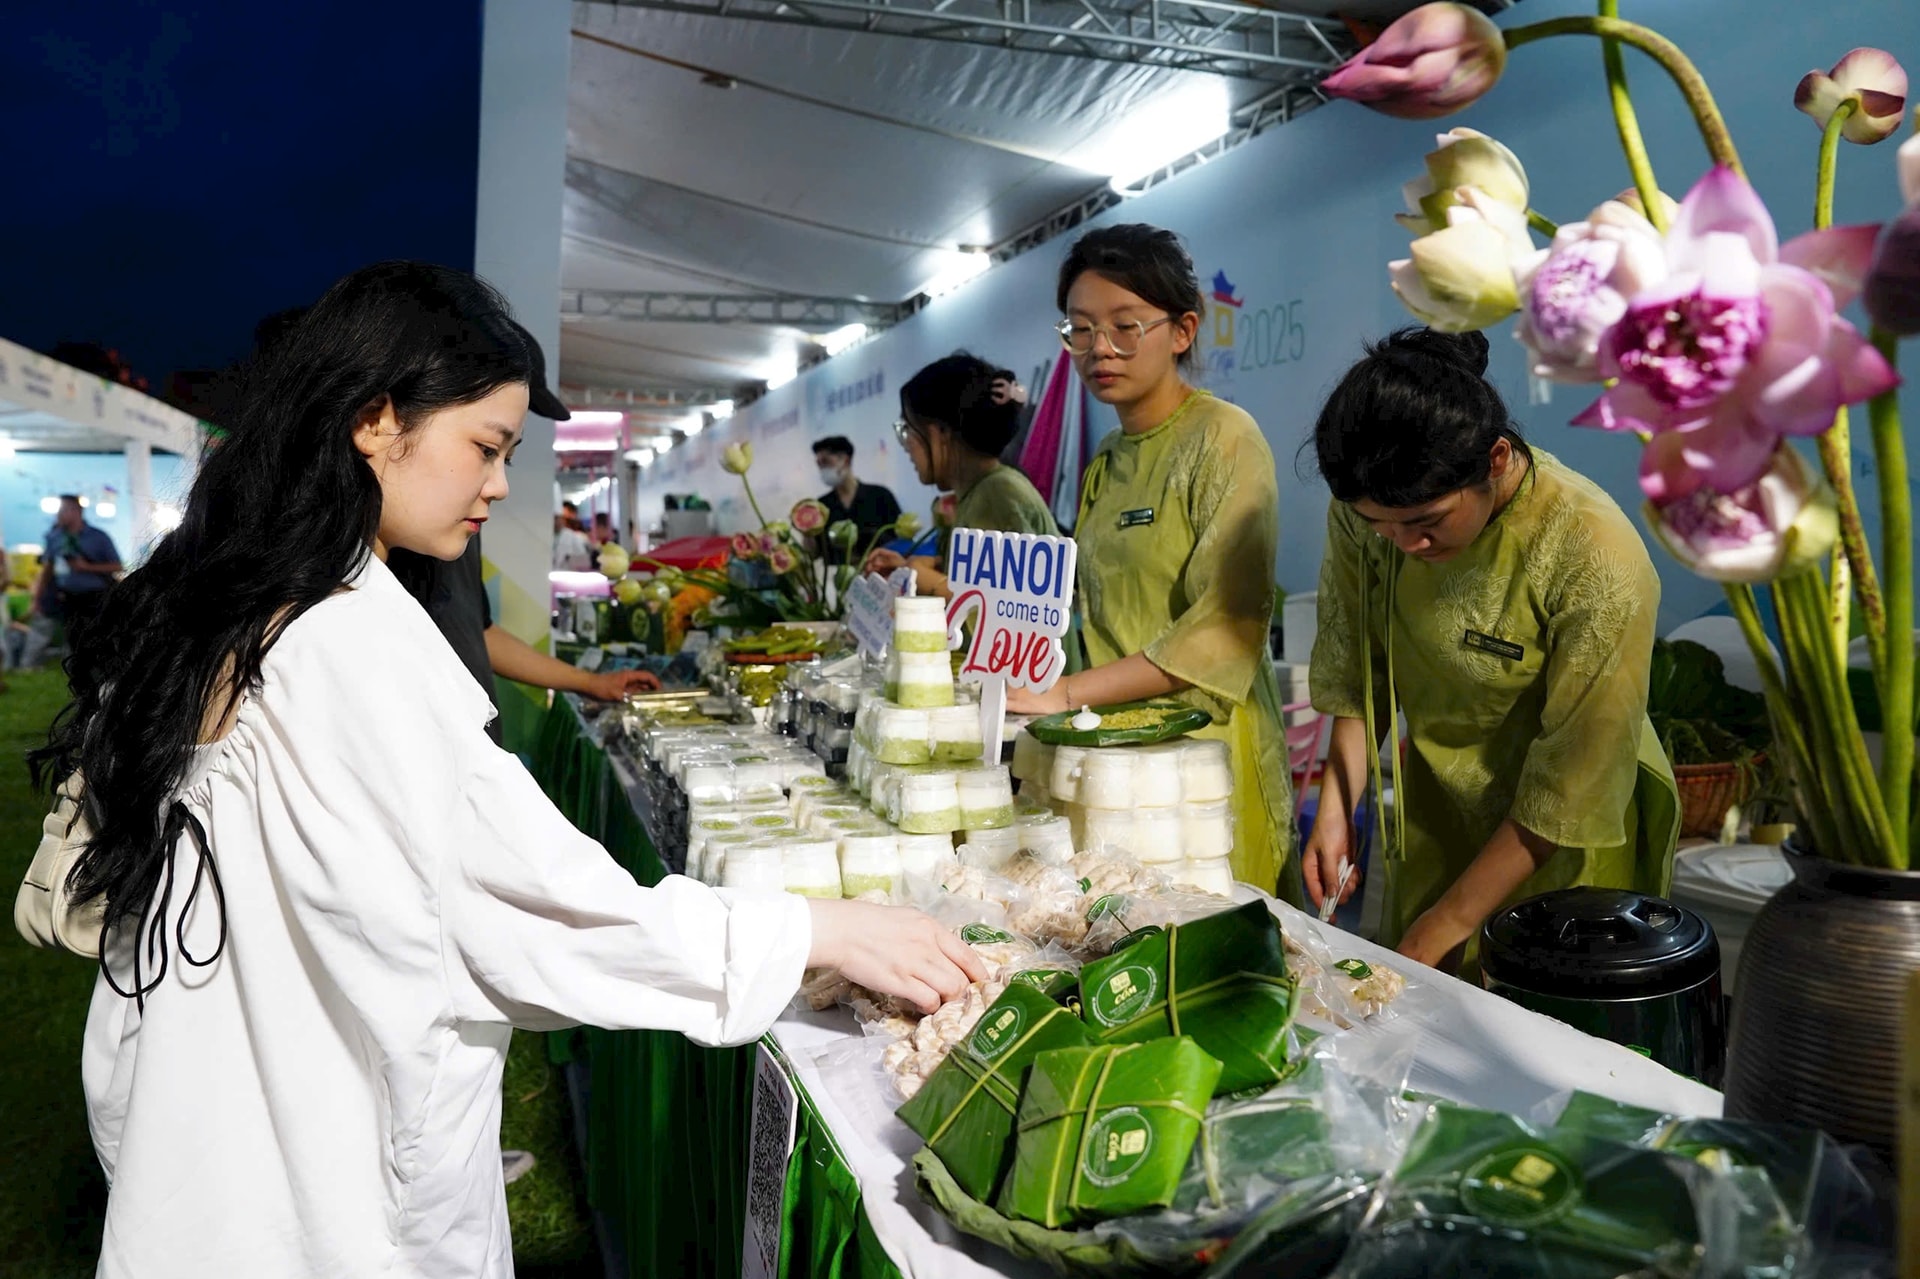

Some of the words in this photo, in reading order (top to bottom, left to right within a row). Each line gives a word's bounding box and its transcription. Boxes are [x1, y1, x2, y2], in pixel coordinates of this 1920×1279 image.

[1239, 299, 1305, 372] 2025
[950, 533, 1066, 599] HANOI
[946, 589, 1055, 684] Love
[996, 599, 1038, 623] come
[1043, 605, 1060, 627] to
